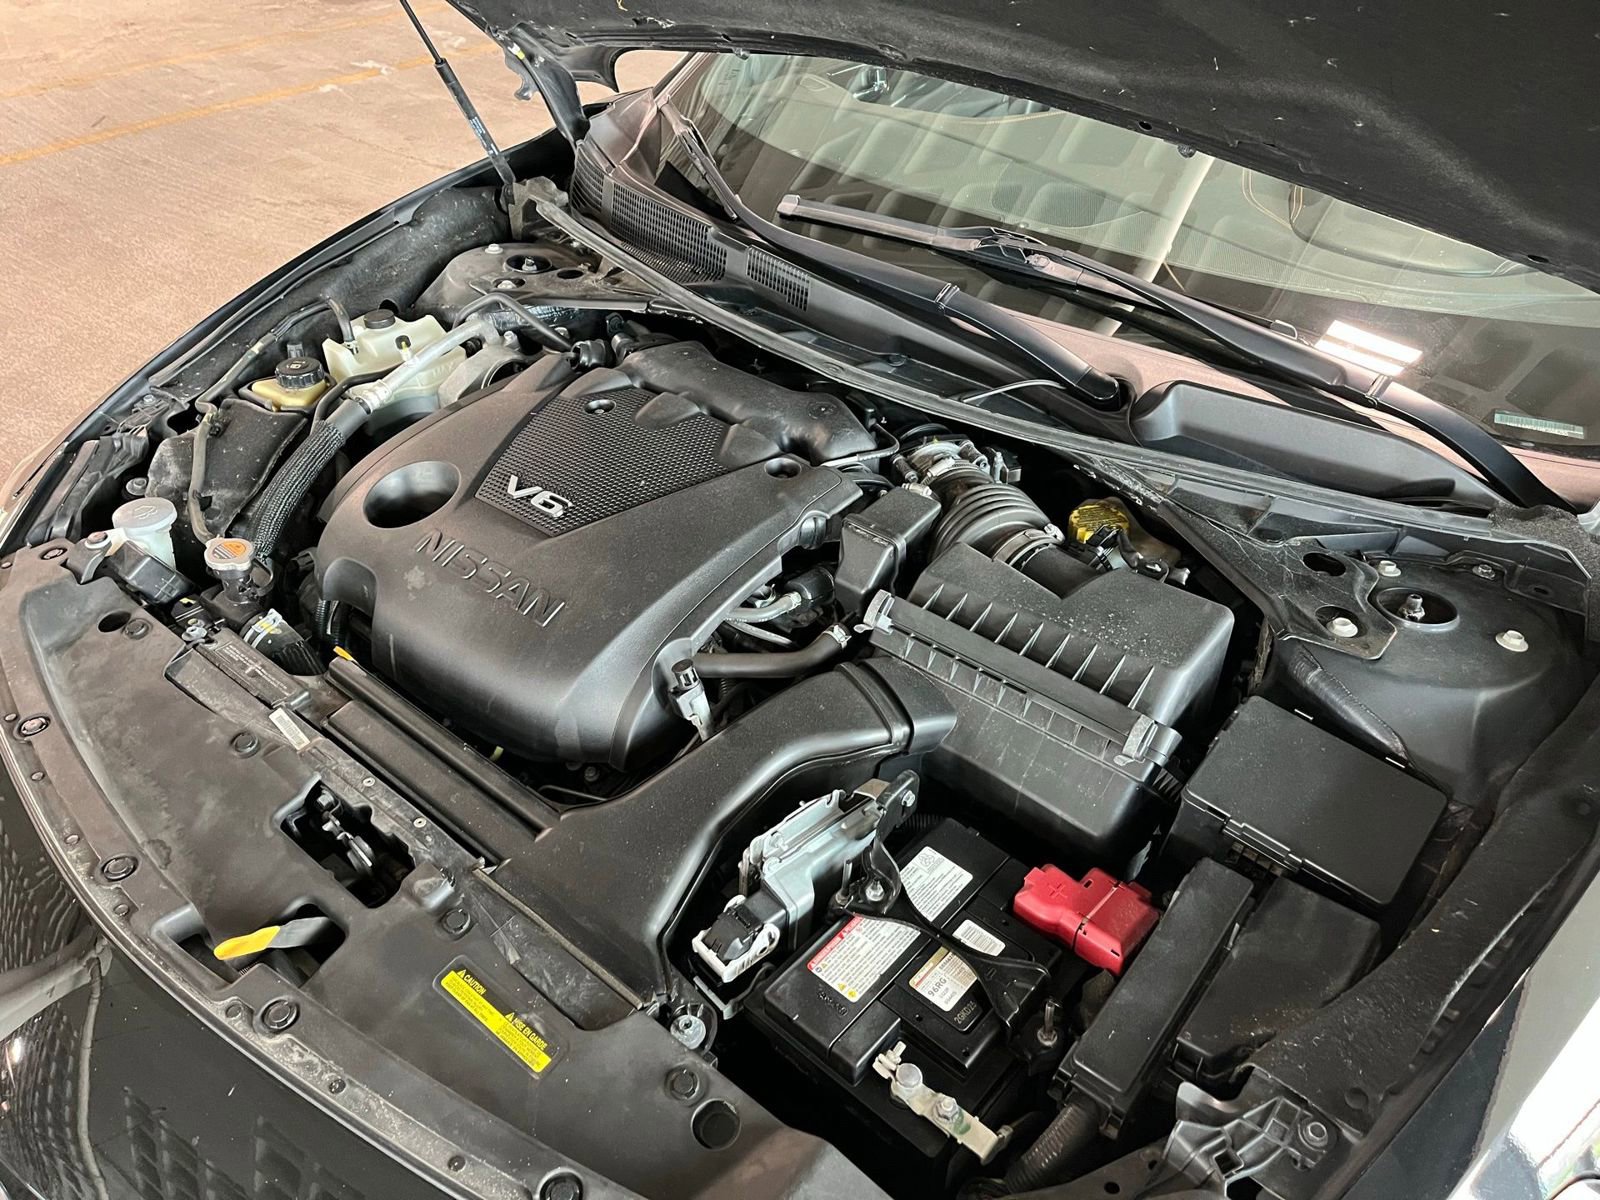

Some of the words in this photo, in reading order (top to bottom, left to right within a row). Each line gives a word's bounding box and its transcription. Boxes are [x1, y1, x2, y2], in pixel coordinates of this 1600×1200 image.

[507, 475, 572, 518] V6
[415, 528, 566, 628] NISSAN
[463, 974, 487, 995] CAUTION
[927, 977, 947, 997] 96RG
[512, 1016, 527, 1033] MISE
[530, 1032, 548, 1051] GARDE
